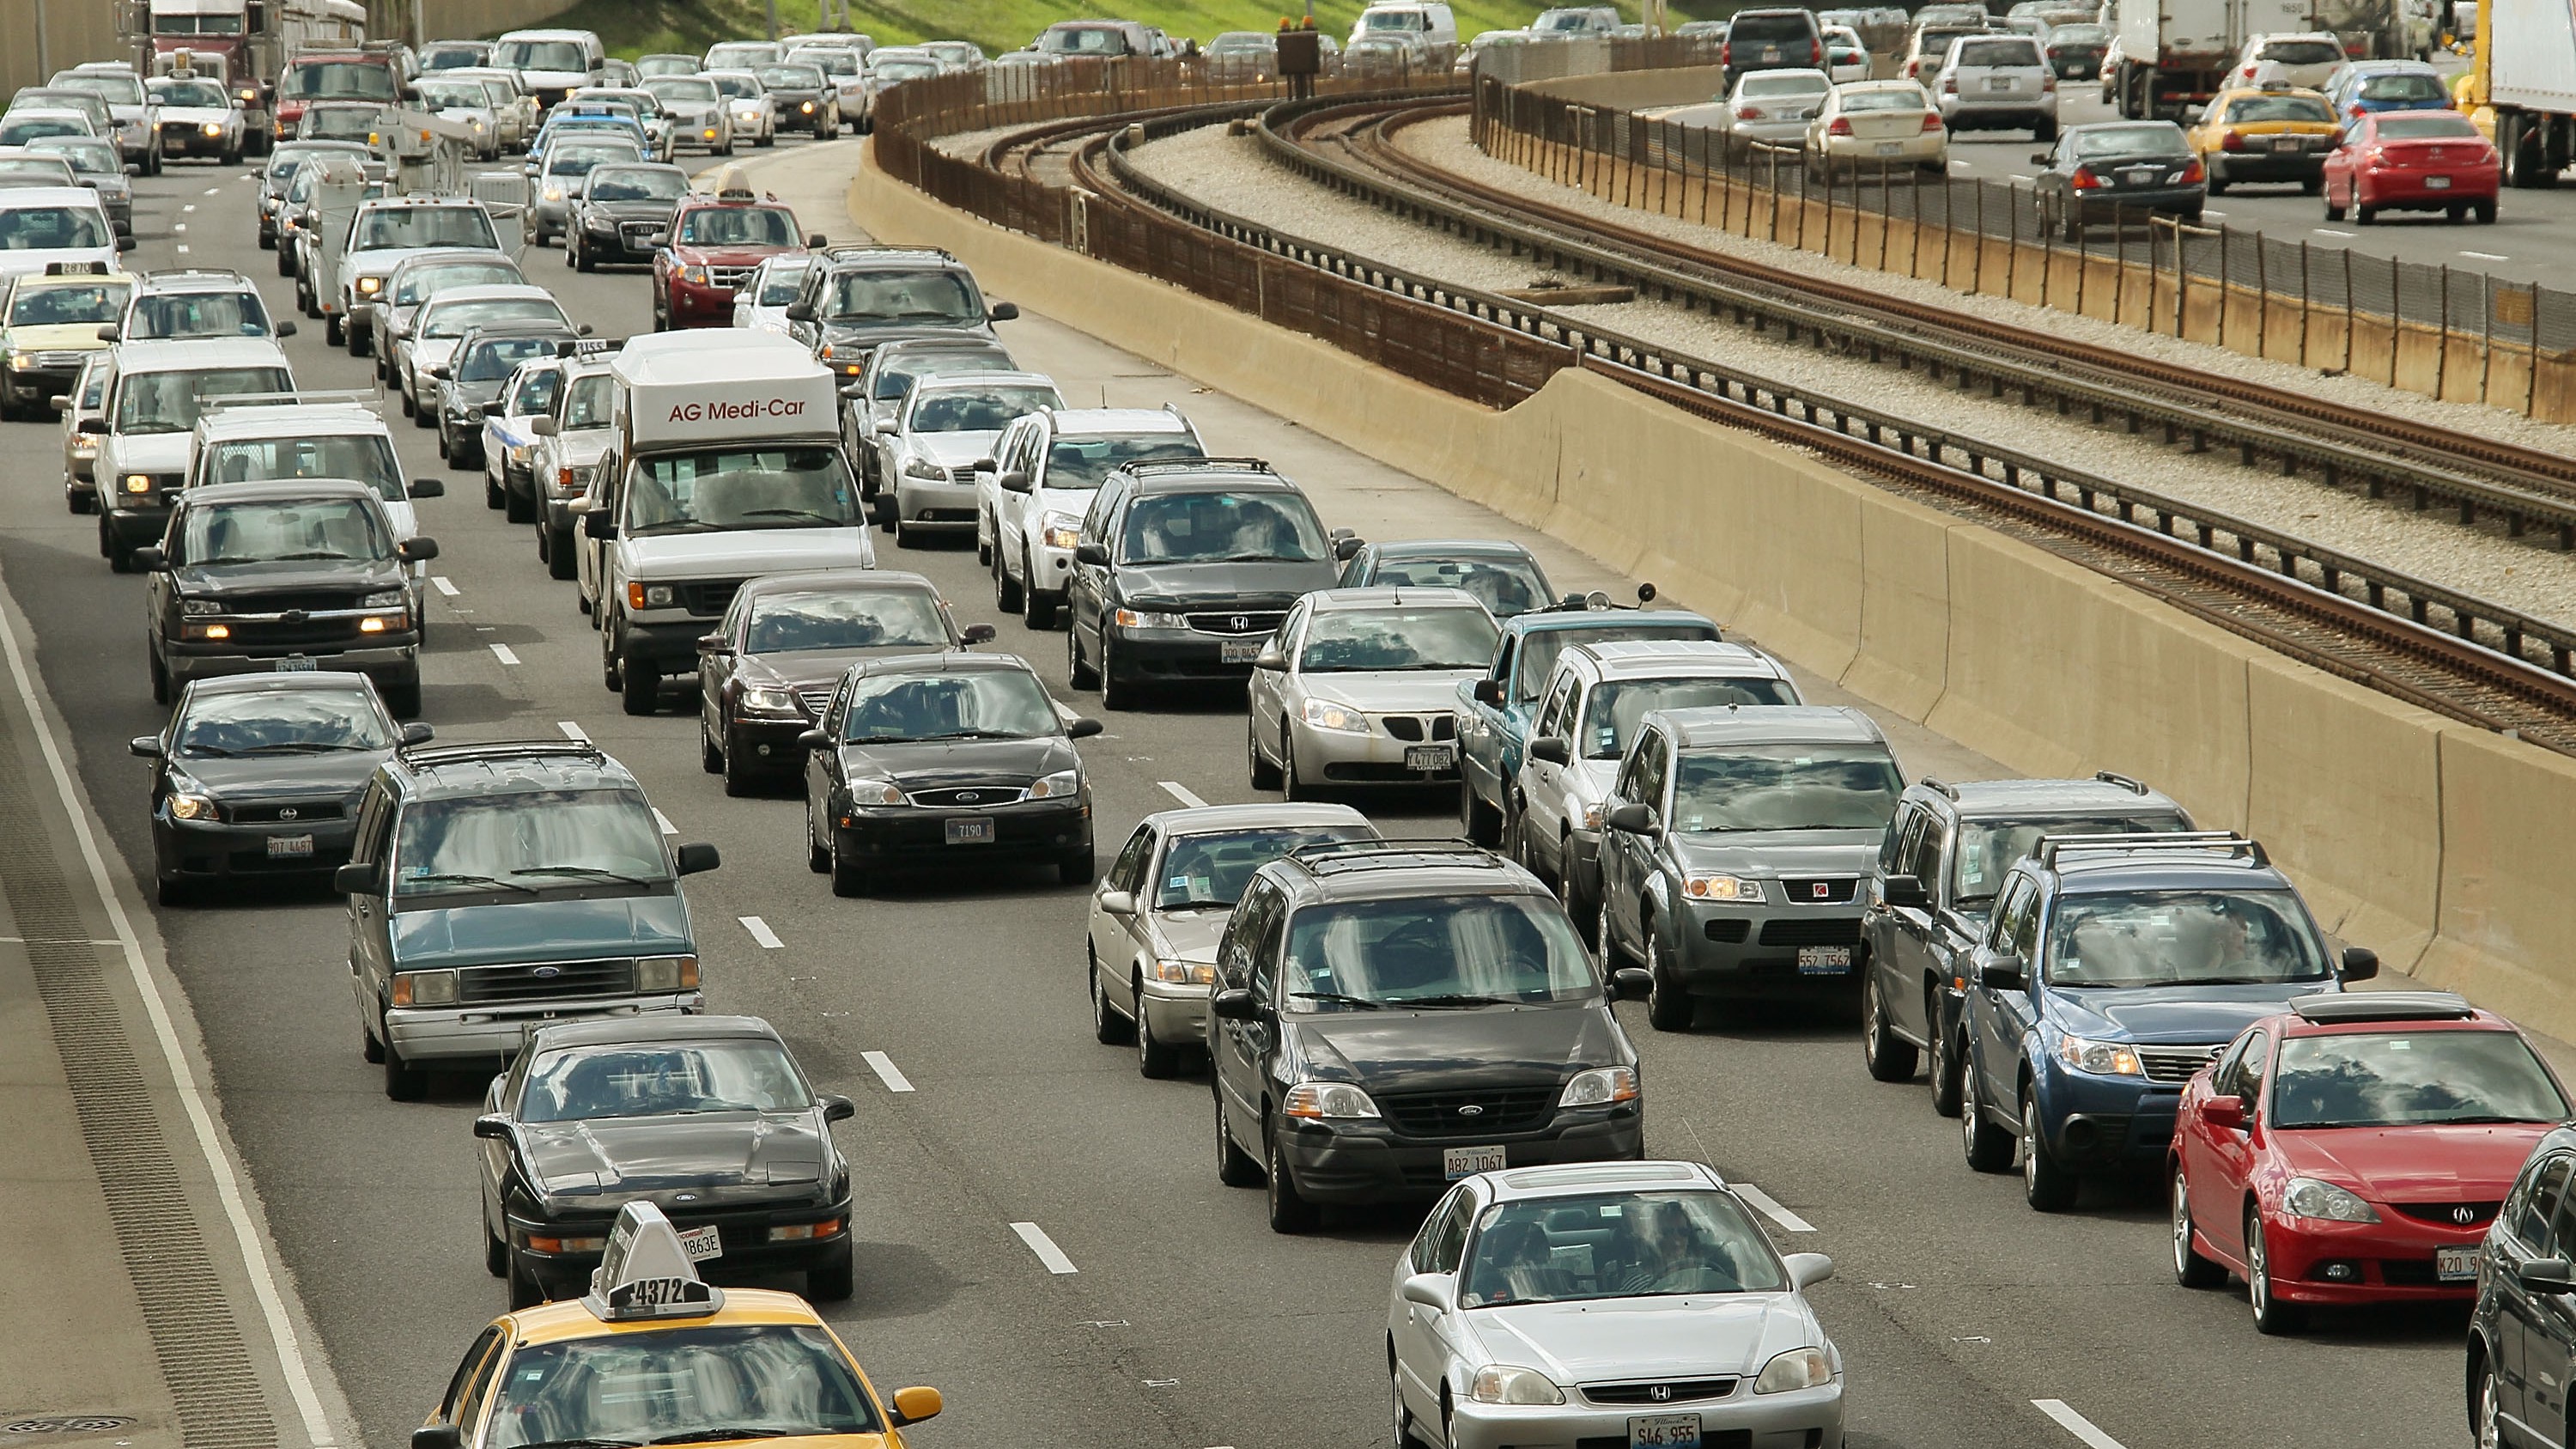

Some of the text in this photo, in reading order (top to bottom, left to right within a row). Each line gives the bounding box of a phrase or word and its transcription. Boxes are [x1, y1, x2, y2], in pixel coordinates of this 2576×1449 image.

[64, 262, 91, 273] 2870
[668, 398, 805, 423] AG Medi-Car
[958, 825, 981, 837] 7190
[1448, 1154, 1503, 1173] A82 1067
[2439, 1256, 2462, 1274] K20
[635, 1278, 683, 1306] 4372
[1637, 1425, 1695, 1446] S46 955
